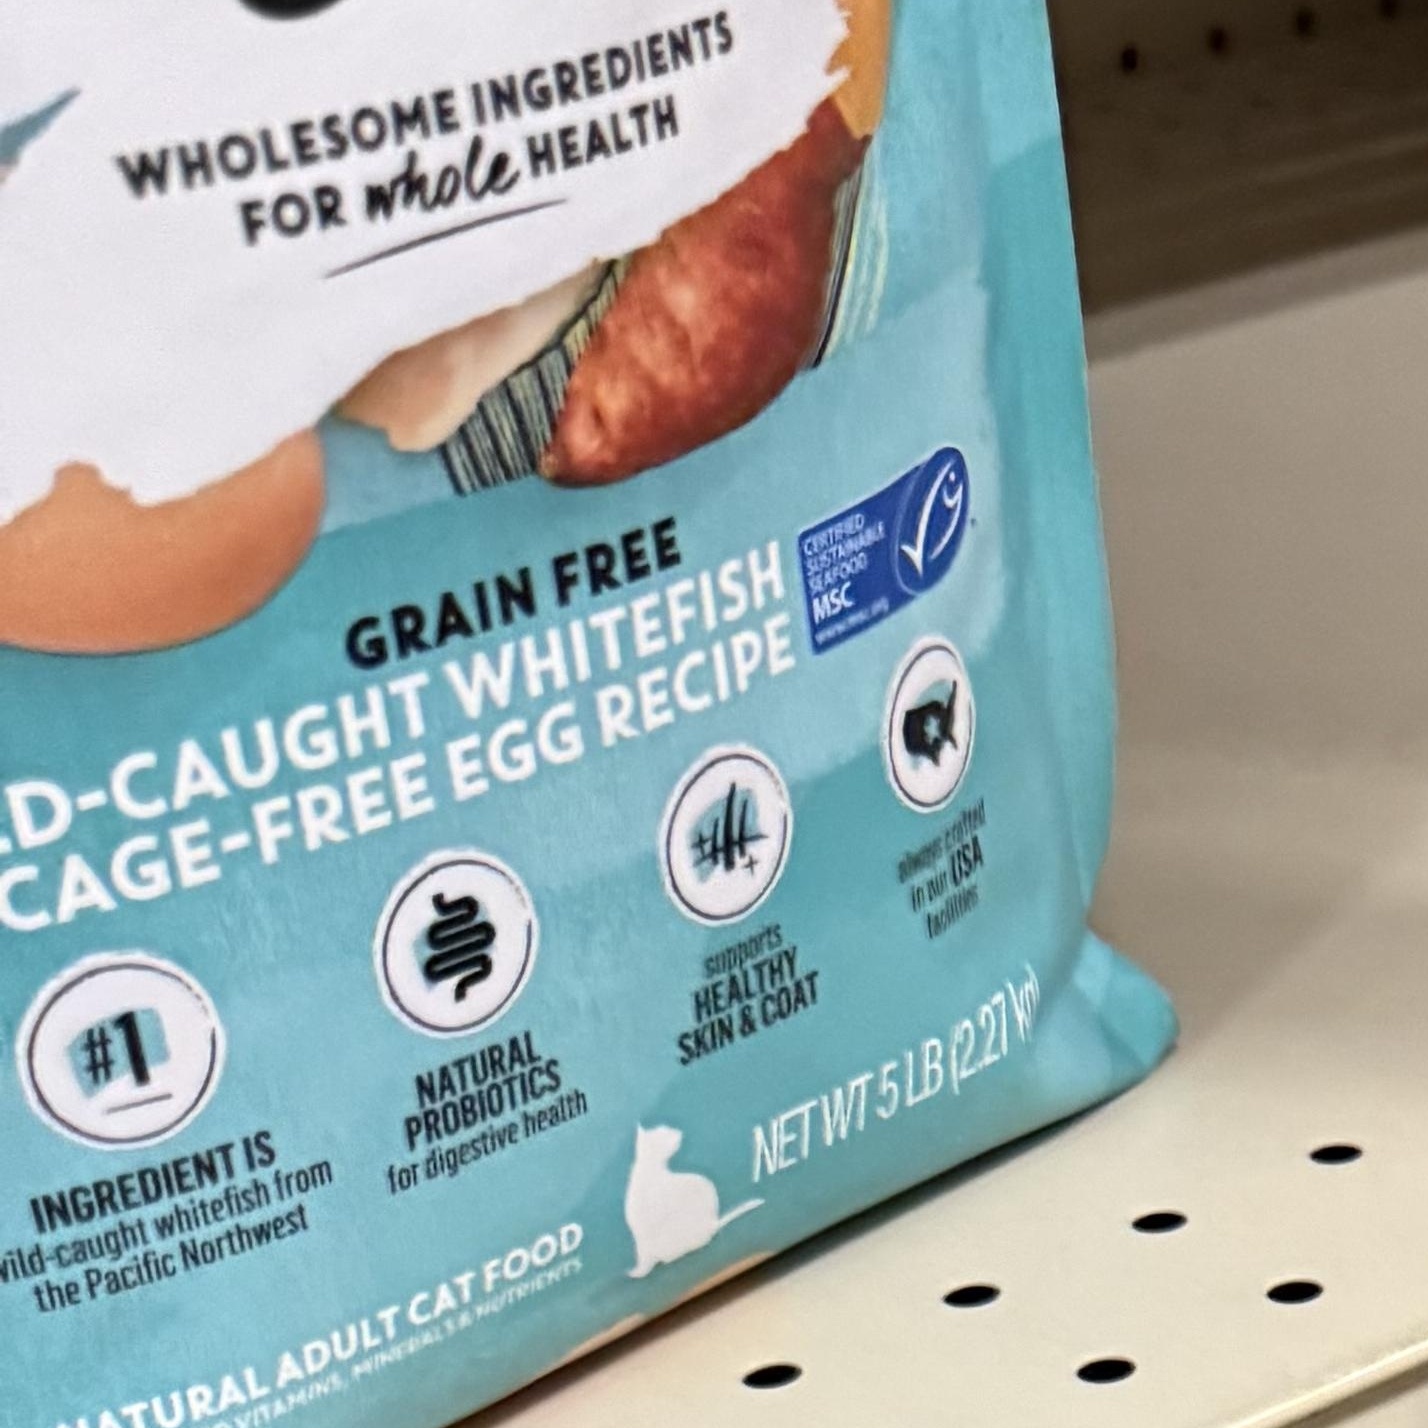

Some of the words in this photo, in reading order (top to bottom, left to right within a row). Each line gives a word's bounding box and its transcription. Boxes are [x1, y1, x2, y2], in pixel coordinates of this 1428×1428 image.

[116, 87, 460, 199] WHOLESOME
[470, 11, 735, 126] INGREDIENTS
[239, 186, 346, 246] FOR
[364, 134, 522, 222] whole
[526, 94, 681, 178] HEALTH
[344, 566, 536, 671] GRAIN
[551, 516, 683, 607] FREE
[811, 581, 855, 625] MSC
[0, 673, 430, 855] D-CAUGHT
[443, 540, 786, 720] WHITEFISH
[0, 752, 431, 932] CAGE-FREE
[446, 701, 584, 796] EGG
[596, 613, 798, 750] RECIPE
[950, 834, 985, 887] USA
[691, 945, 798, 1022] HEALTHY
[703, 923, 784, 980] supports
[83, 1010, 151, 1088] #1
[415, 1029, 542, 1109] NATURAL
[676, 1015, 735, 1066] SKIN
[739, 1005, 757, 1038] &
[761, 969, 820, 1029] COAT
[387, 1163, 420, 1196] for
[424, 1121, 520, 1178] digestive
[521, 1088, 588, 1139] health
[404, 1058, 562, 1152] PROBIOTICS
[752, 1100, 819, 1183] NET
[820, 1071, 874, 1148] WT
[876, 1060, 899, 1120] 5
[904, 1037, 944, 1108] LB
[29, 1142, 235, 1235] INGREDIENT
[242, 1130, 276, 1172] IS
[153, 1179, 271, 1241] whitefish
[274, 1160, 333, 1201] from
[33, 1280, 81, 1314] the
[84, 1249, 177, 1301] Pacific
[179, 1203, 309, 1270] Northwest
[275, 1304, 402, 1388] ADULT
[406, 1271, 480, 1327] CAT
[482, 1221, 585, 1291] FOOD
